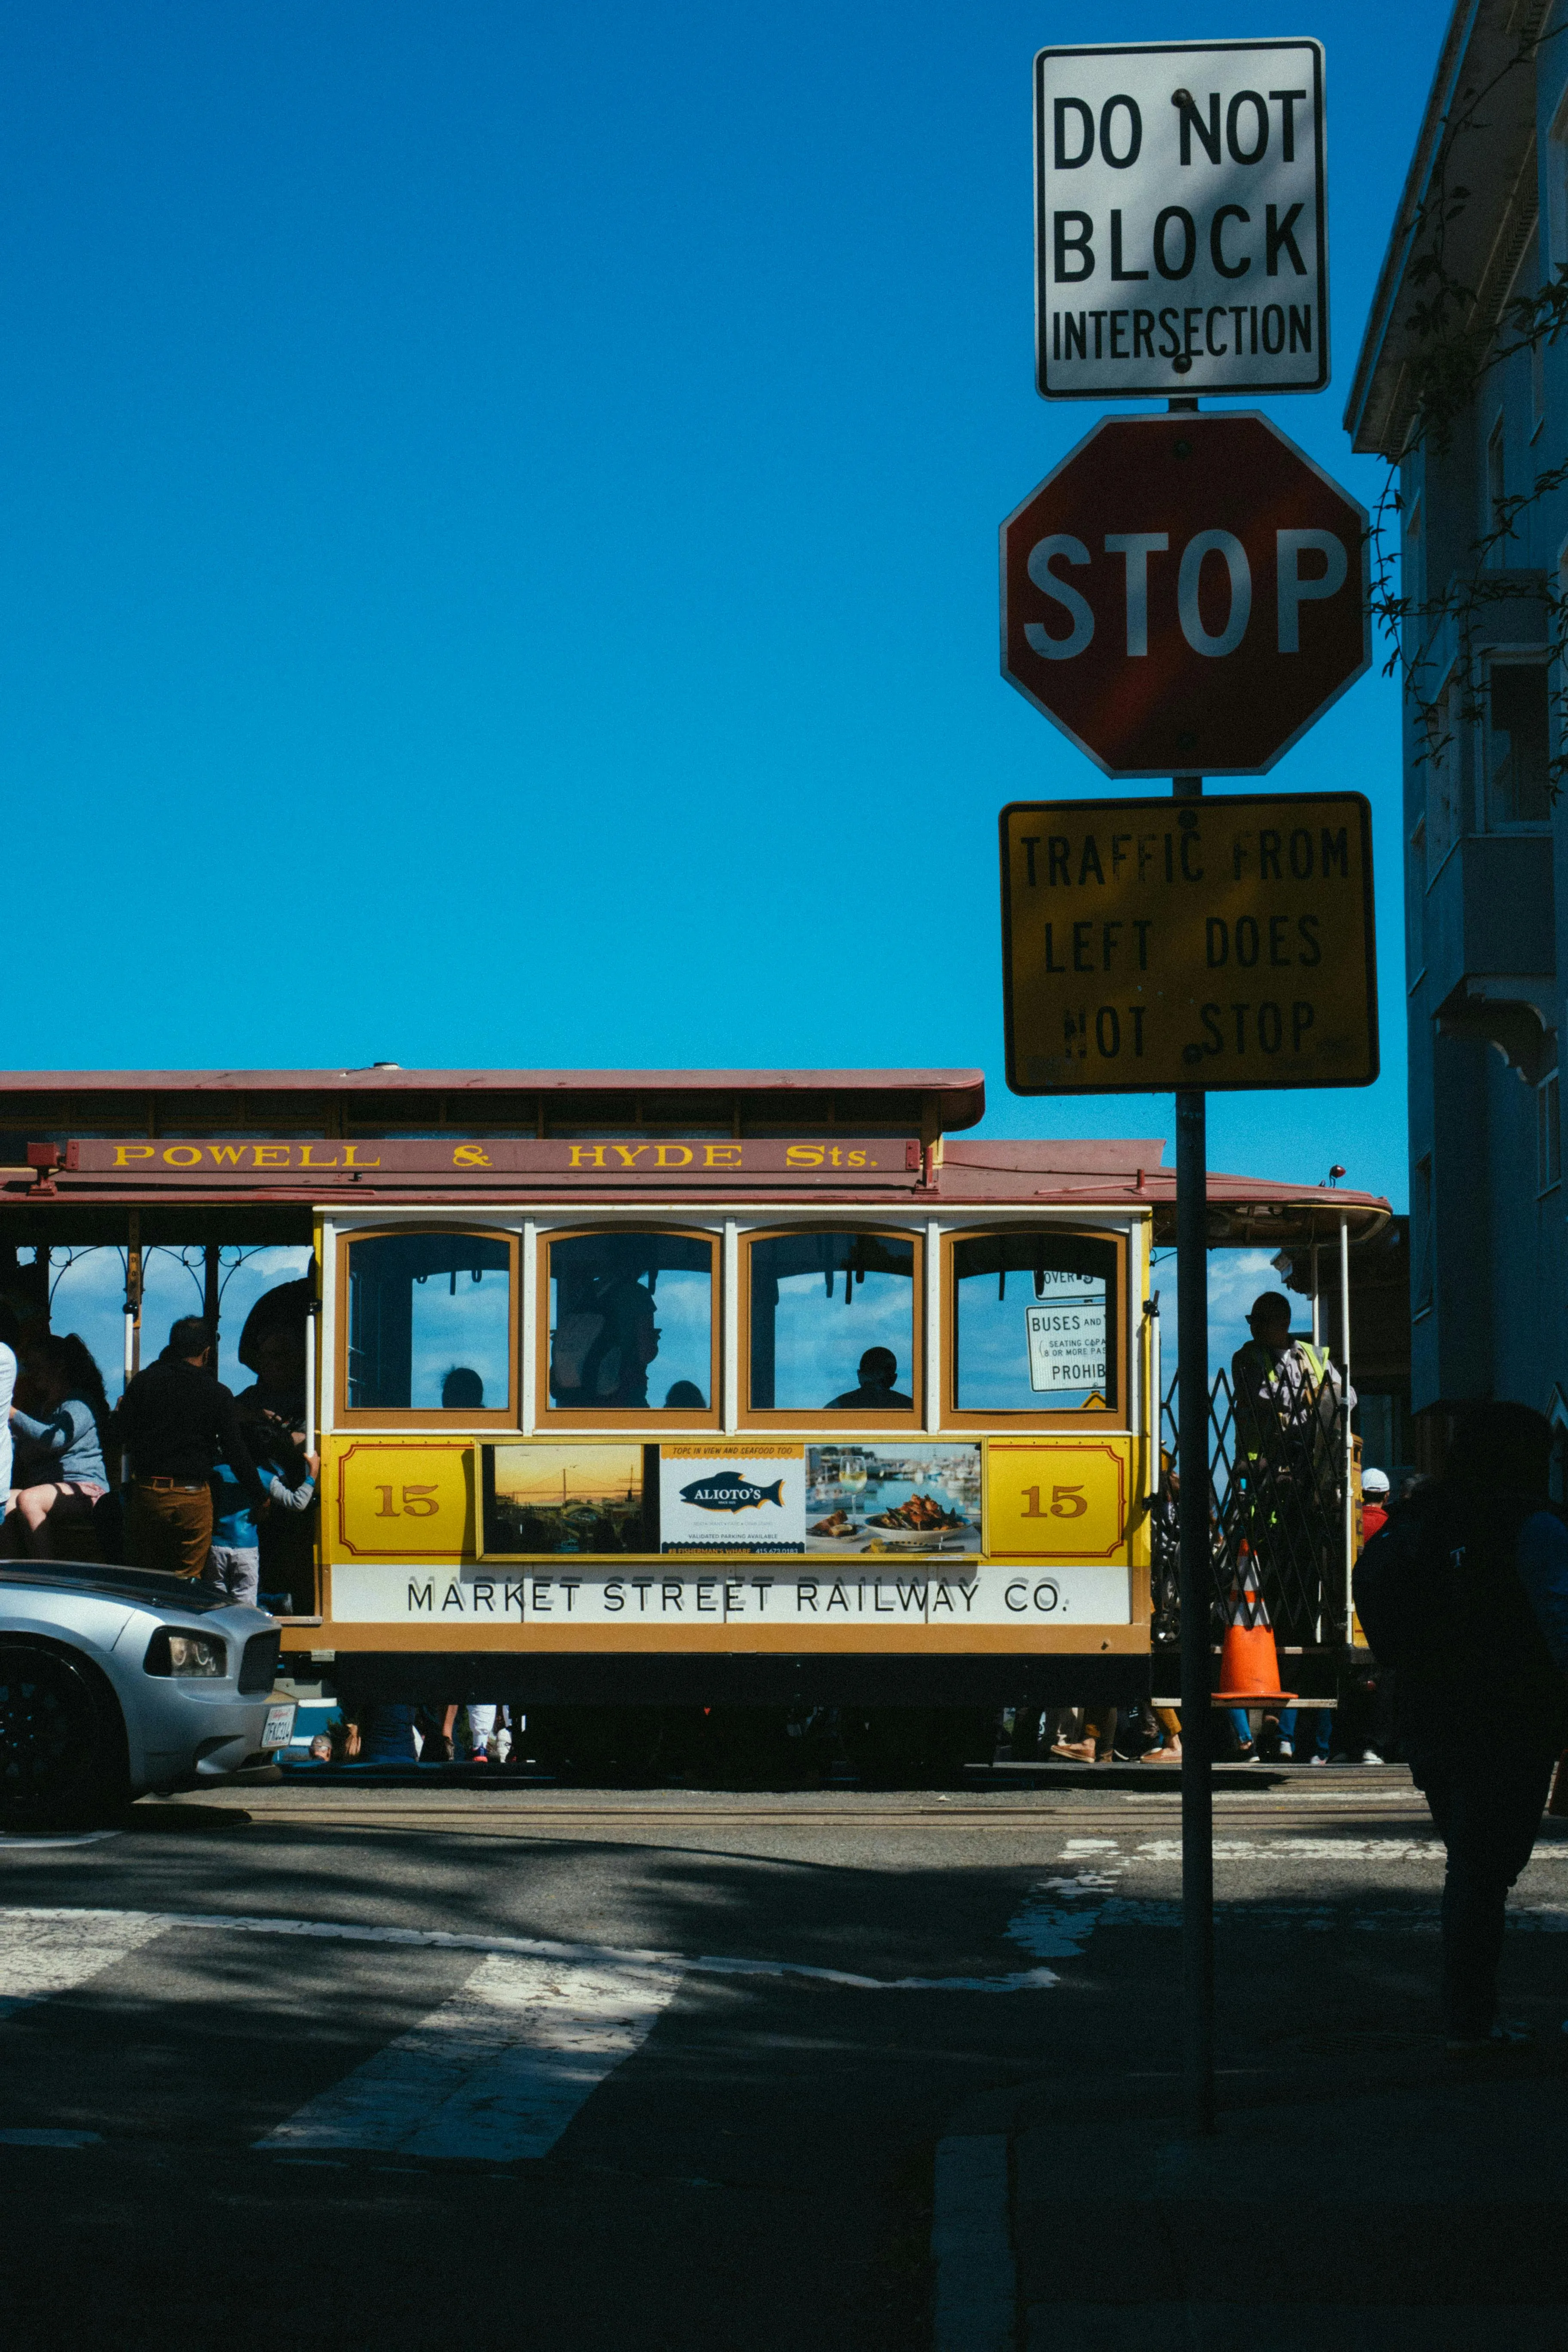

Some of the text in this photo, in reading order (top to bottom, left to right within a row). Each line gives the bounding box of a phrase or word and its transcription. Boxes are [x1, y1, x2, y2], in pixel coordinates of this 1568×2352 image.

[1054, 89, 1307, 169] DO NOT
[1054, 203, 1308, 283] BLOCK
[1053, 303, 1312, 360] INTERSECTION
[1024, 529, 1348, 660] STOP
[1020, 827, 1350, 887] TRAFFIC FROM
[1045, 914, 1322, 973] LEFT DOES
[1064, 1001, 1314, 1058] NOT STOP
[112, 1145, 878, 1166] POWELL & HYDE Sts.
[1044, 1272, 1074, 1284] OVER
[1033, 1316, 1080, 1331] BUSES
[1049, 1339, 1082, 1347] SEATING
[1052, 1364, 1106, 1380] PROHIB
[375, 1485, 439, 1517] 15
[694, 1488, 761, 1499] ALIOTO'S
[1021, 1485, 1088, 1518] 15
[407, 1583, 1068, 1612] MARKET STREET RAILWAY CO.
